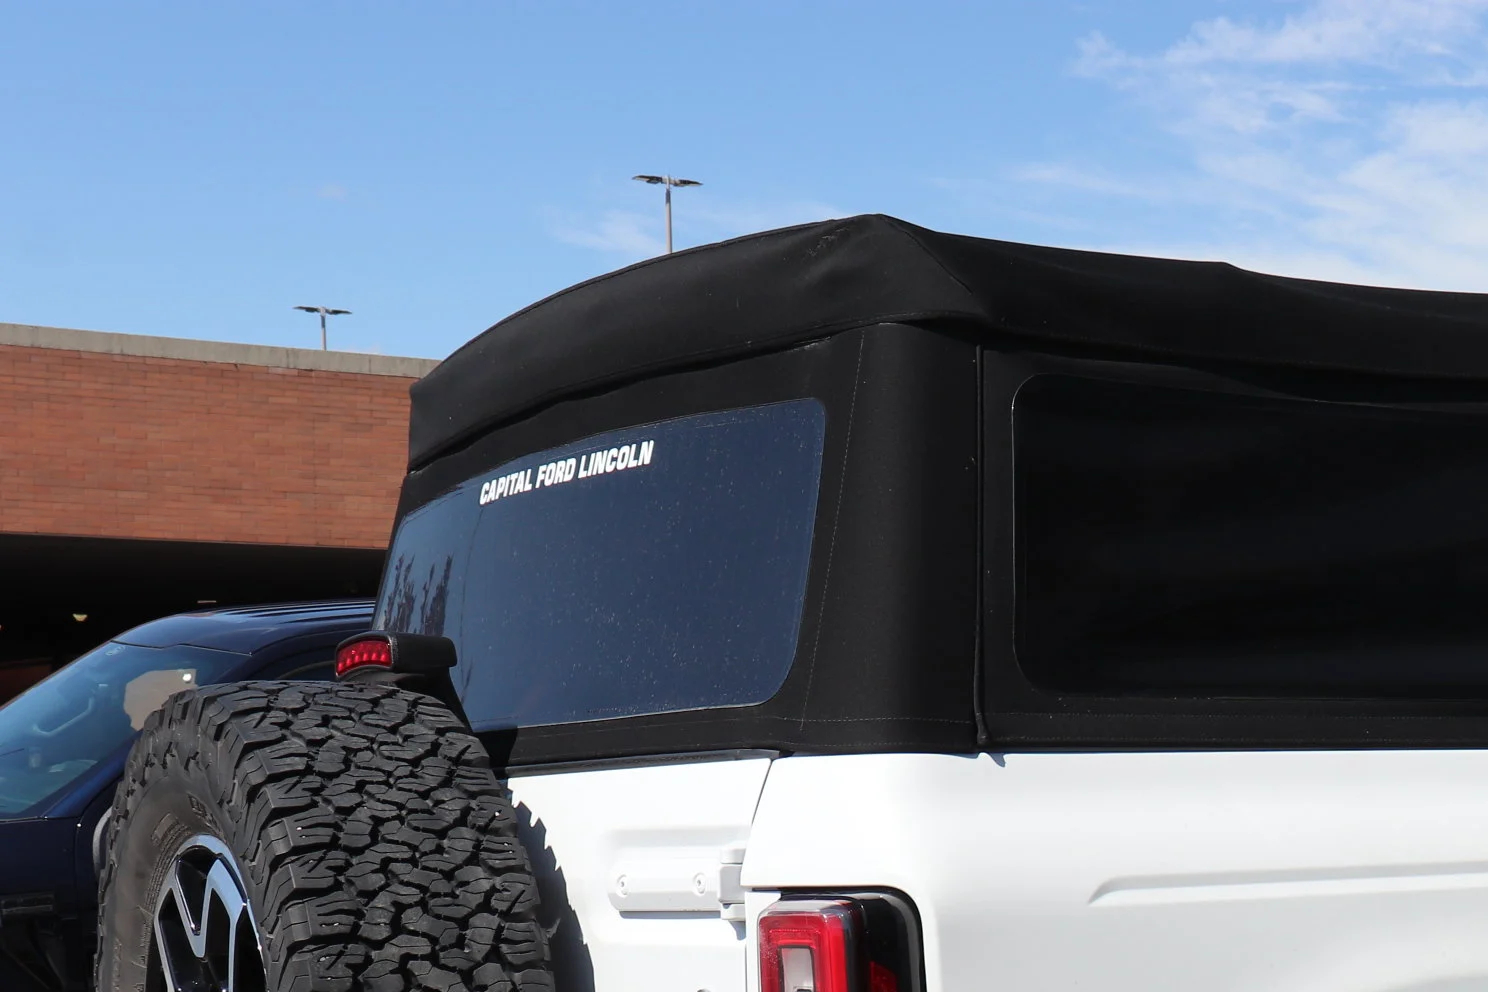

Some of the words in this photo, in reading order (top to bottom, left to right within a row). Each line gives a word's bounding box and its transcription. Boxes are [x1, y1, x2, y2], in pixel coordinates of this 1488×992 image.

[479, 468, 532, 506] CAPITAL
[535, 457, 576, 489] FORD
[577, 440, 655, 479] LINCOLN
